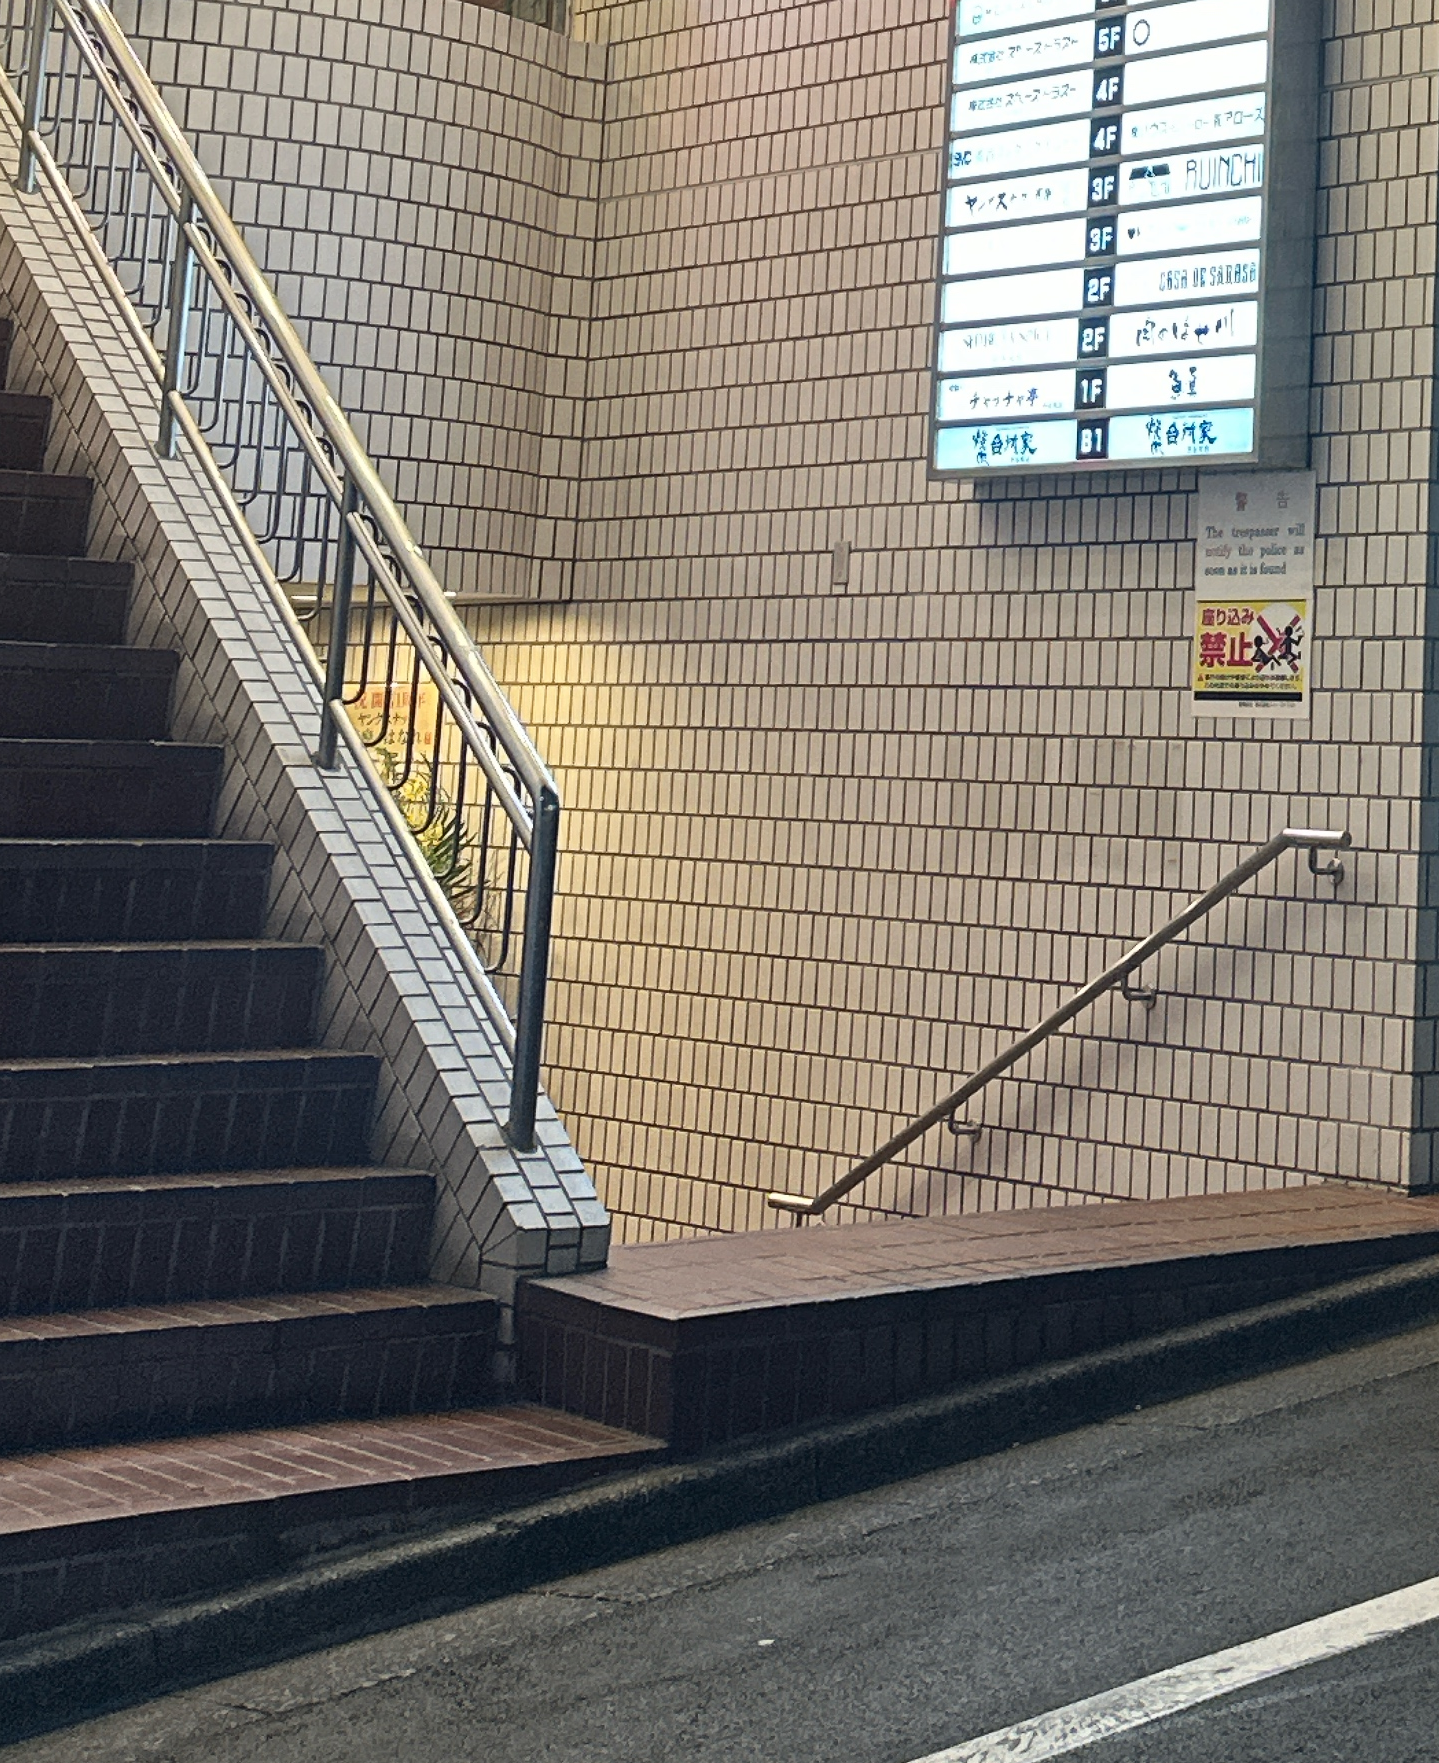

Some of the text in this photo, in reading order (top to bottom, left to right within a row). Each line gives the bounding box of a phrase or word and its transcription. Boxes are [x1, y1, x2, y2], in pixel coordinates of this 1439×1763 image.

[1098, 27, 1121, 51] 5F
[1096, 76, 1119, 102] 4F
[1094, 126, 1117, 152] 4F
[1091, 176, 1115, 202] 3F
[1087, 277, 1110, 301] 2F
[1082, 327, 1105, 352] 2F
[1081, 378, 1103, 403] 1F
[1082, 426, 1103, 452] B1
[1206, 525, 1224, 539] The
[1287, 523, 1305, 537] will
[1260, 561, 1287, 576] found
[1200, 632, 1254, 668] 禁止
